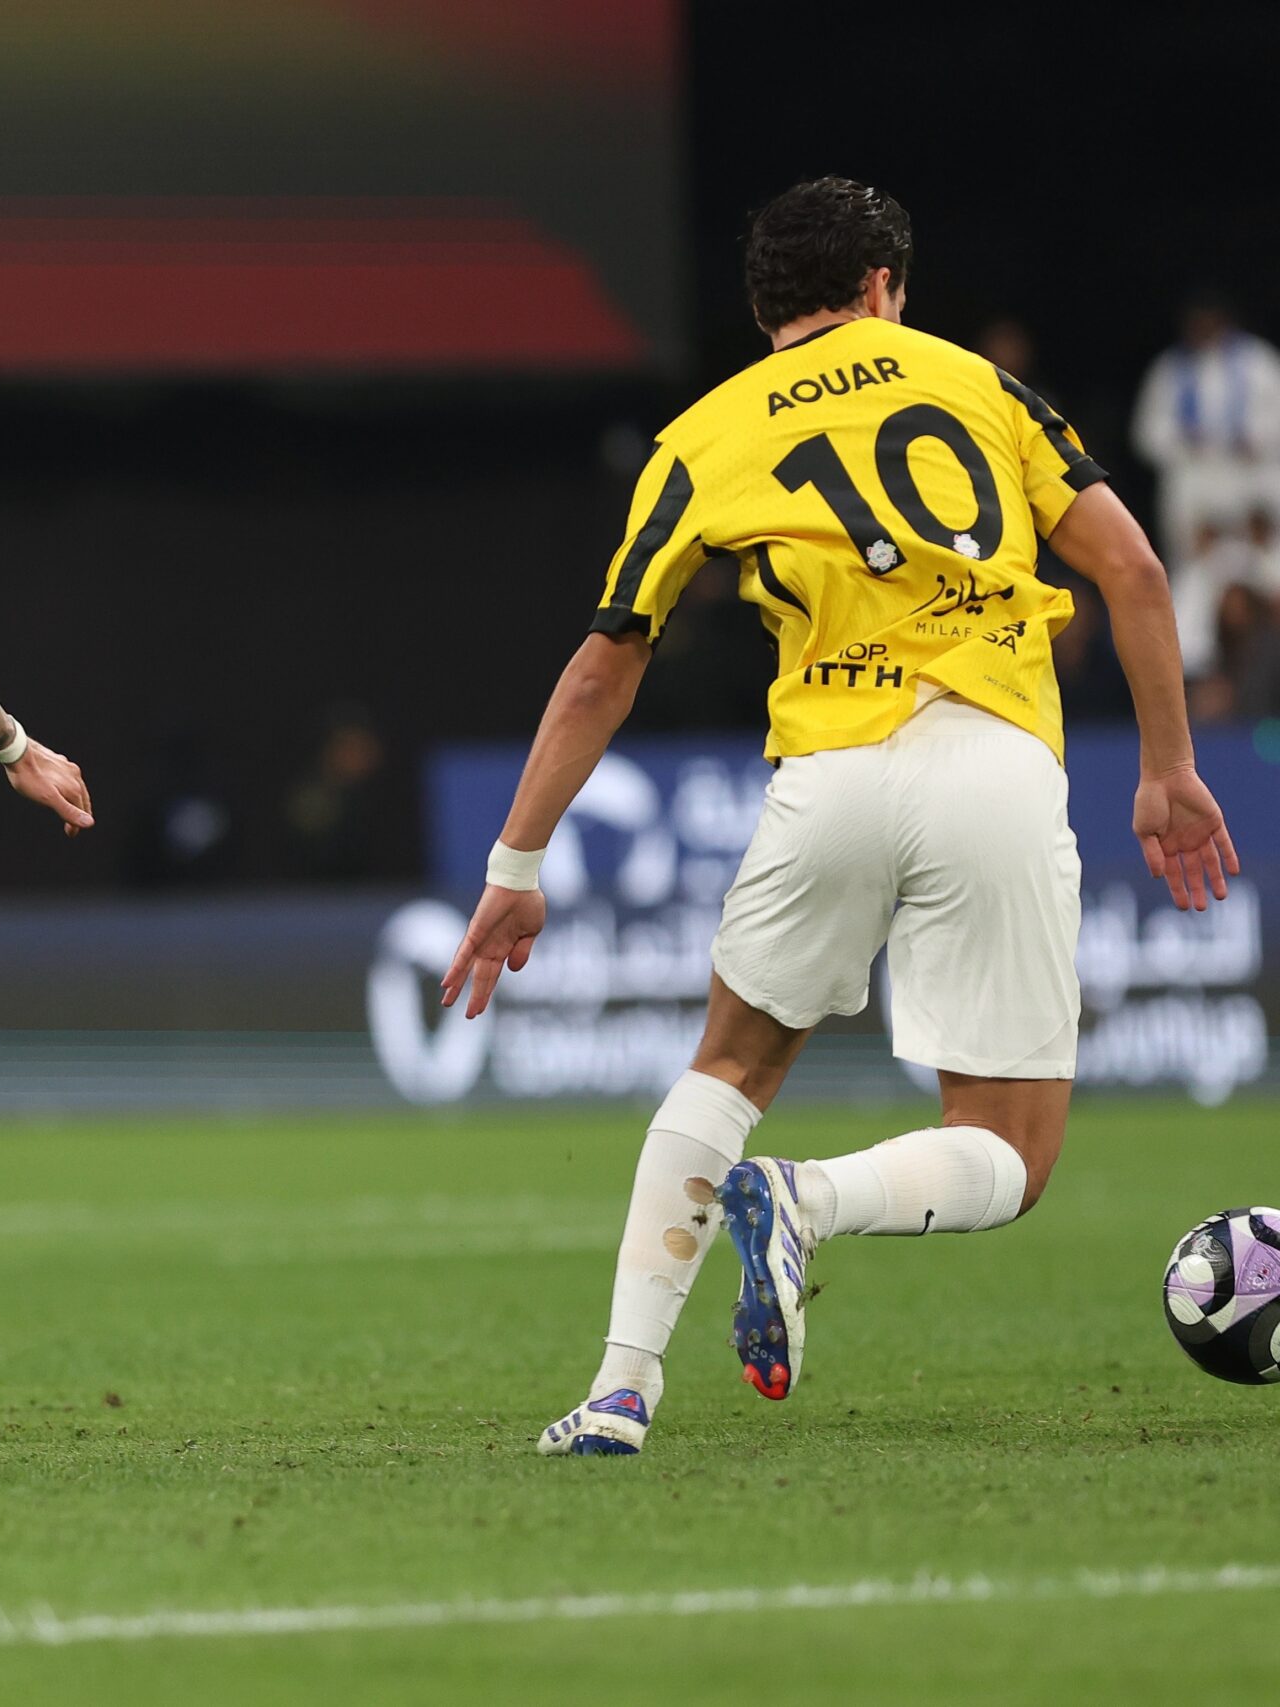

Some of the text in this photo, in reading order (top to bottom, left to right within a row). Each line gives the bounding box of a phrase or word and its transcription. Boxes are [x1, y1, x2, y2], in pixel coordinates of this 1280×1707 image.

[768, 356, 907, 417] AOUAR
[771, 402, 1004, 576] 10
[915, 622, 973, 638] MILAF
